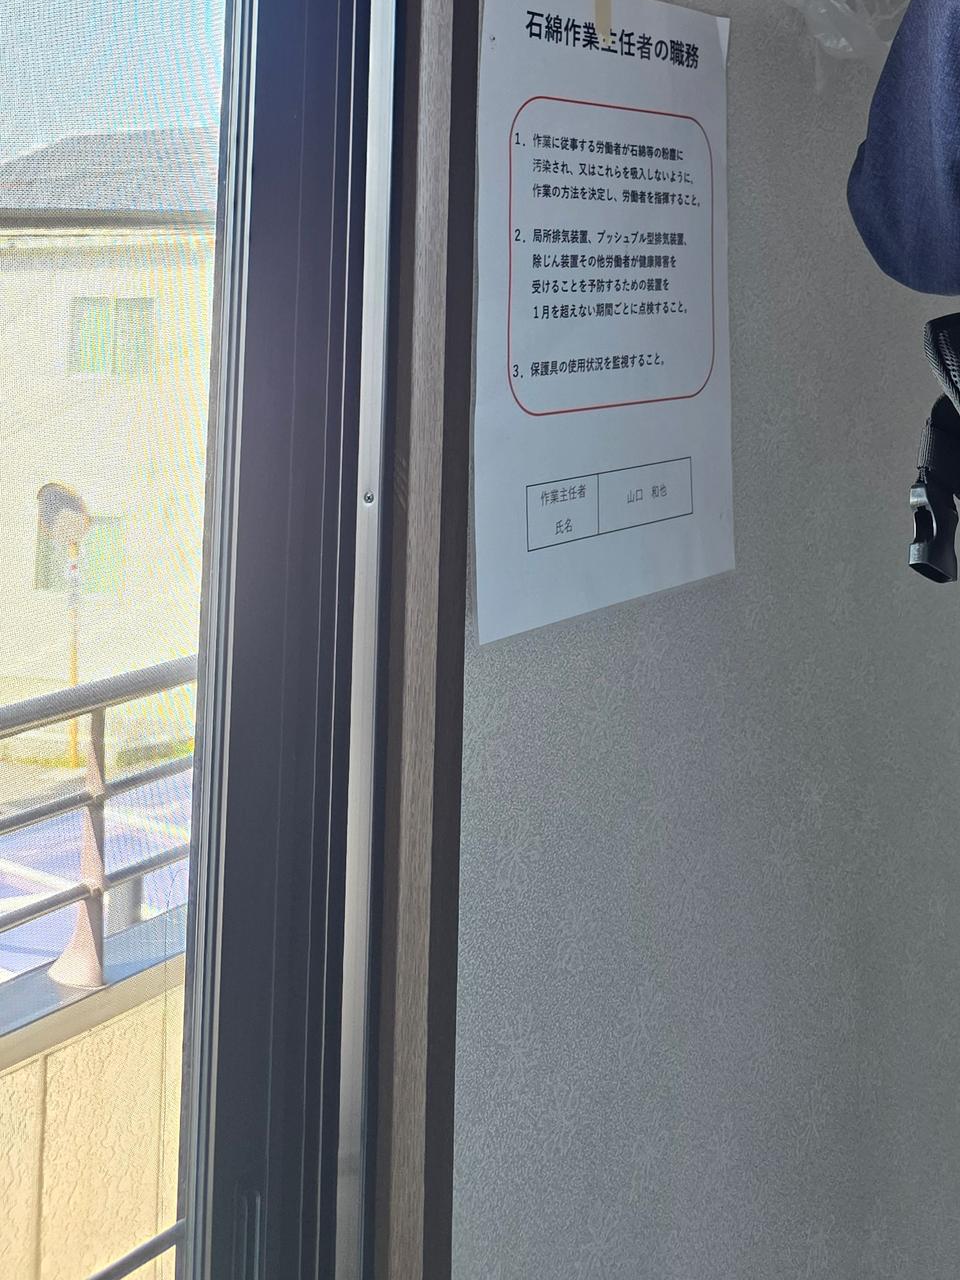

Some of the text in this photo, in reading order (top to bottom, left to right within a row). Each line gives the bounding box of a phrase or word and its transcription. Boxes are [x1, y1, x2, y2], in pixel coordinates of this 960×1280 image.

[525, 10, 699, 70] 石綿作業主任者の職務
[532, 254, 677, 269] 除じん装置その他労働者が健康障害を
[531, 277, 669, 294] 受けることを予防するための装置を
[530, 353, 665, 377] 保護具の使用状況を監視すること。
[541, 484, 586, 507] 作業主任者
[627, 488, 643, 504] 山口
[555, 519, 573, 536] 氏名
